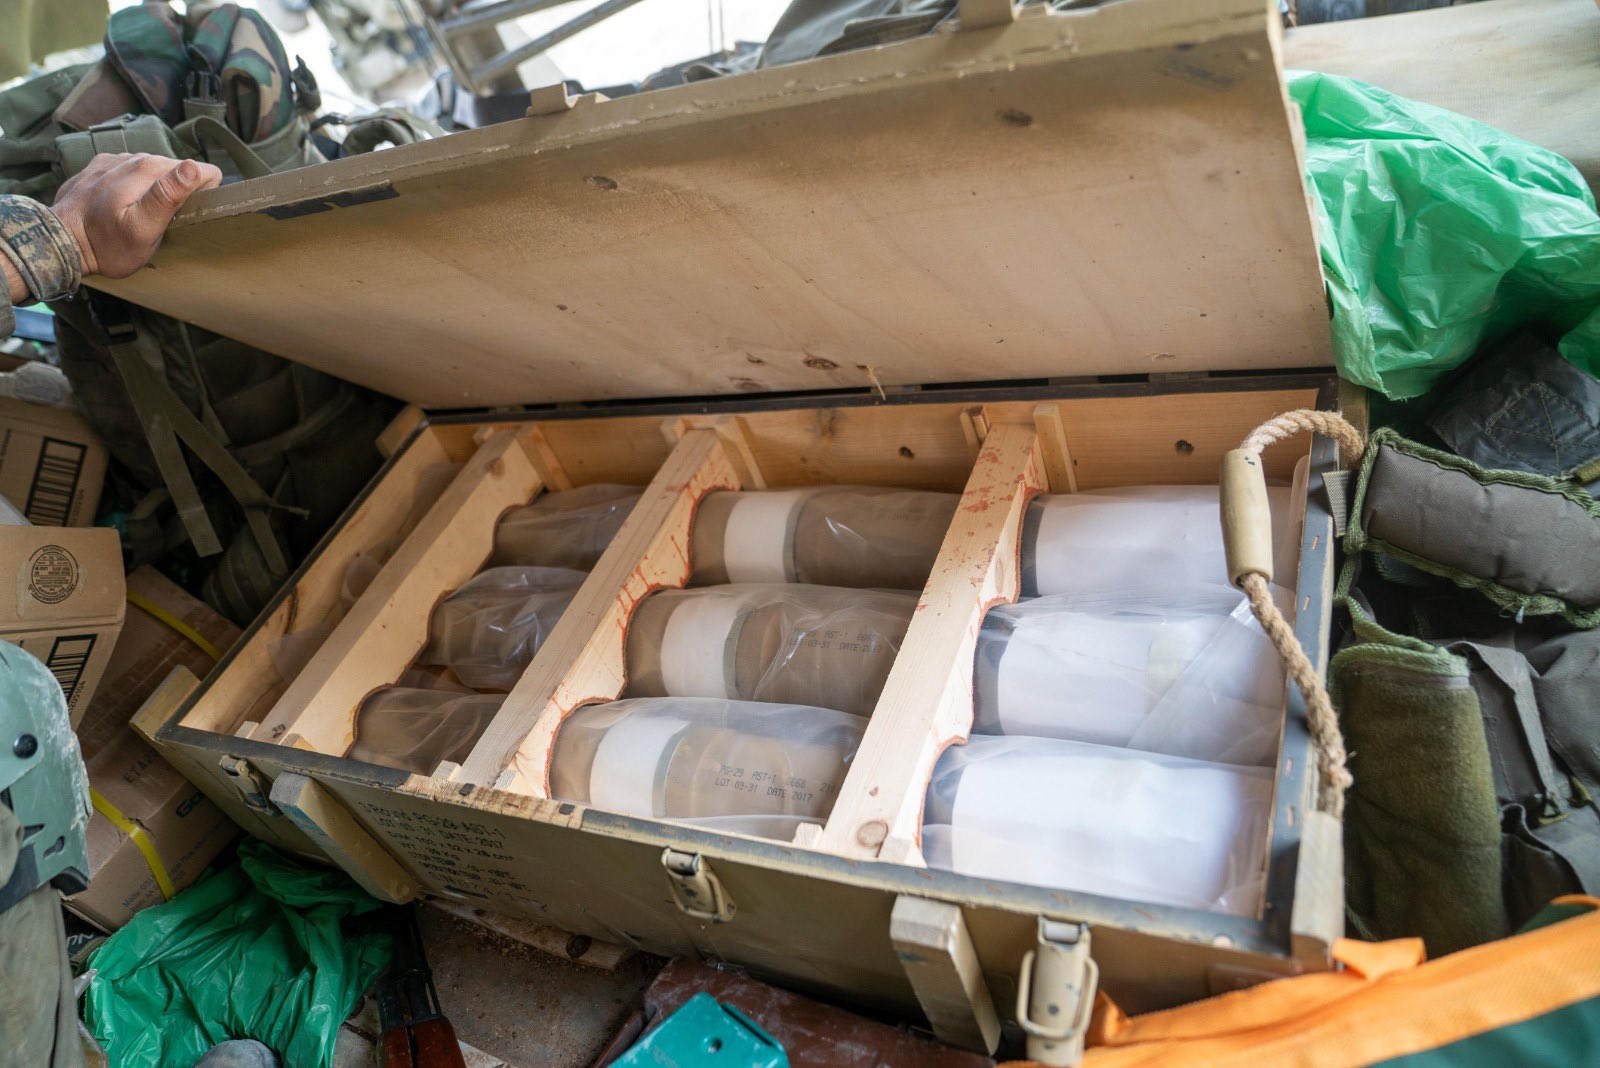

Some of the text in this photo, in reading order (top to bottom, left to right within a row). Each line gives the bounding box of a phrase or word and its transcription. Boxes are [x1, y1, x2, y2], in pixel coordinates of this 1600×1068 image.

[839, 642, 859, 651] DATE
[714, 778, 813, 801] LOT 03-31 DATE 2017
[436, 829, 477, 845] DATE
[474, 836, 504, 849] 2017
